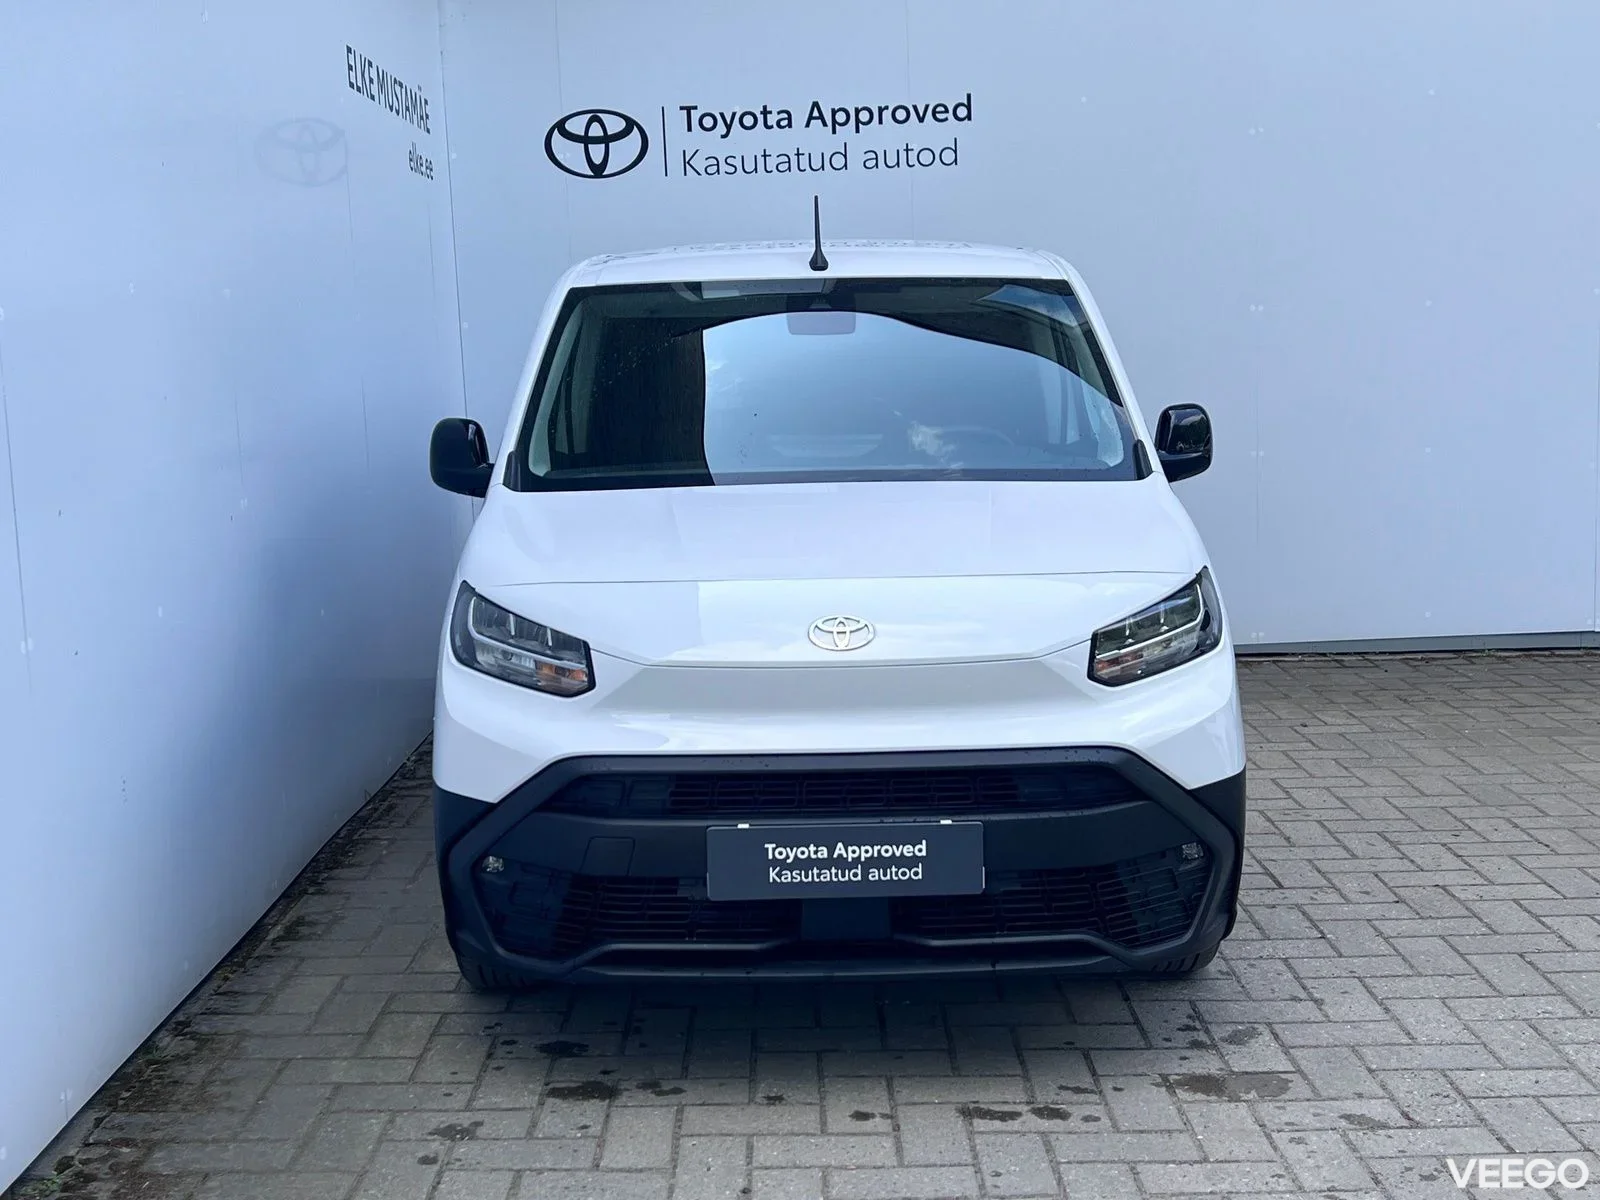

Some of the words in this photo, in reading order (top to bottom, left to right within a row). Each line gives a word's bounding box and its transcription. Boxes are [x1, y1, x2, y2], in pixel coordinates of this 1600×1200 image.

[346, 44, 376, 102] ELKE
[376, 64, 431, 135] MUSTAMÄE
[679, 104, 794, 139] Toyota
[804, 93, 973, 135] Approved
[408, 141, 434, 181] elke.ee
[682, 142, 849, 177] Kasutatud
[862, 137, 959, 170] autod
[764, 843, 828, 864] Toyota
[833, 839, 927, 862] Approved
[769, 864, 862, 883] Kasutatud
[868, 863, 922, 881] autod
